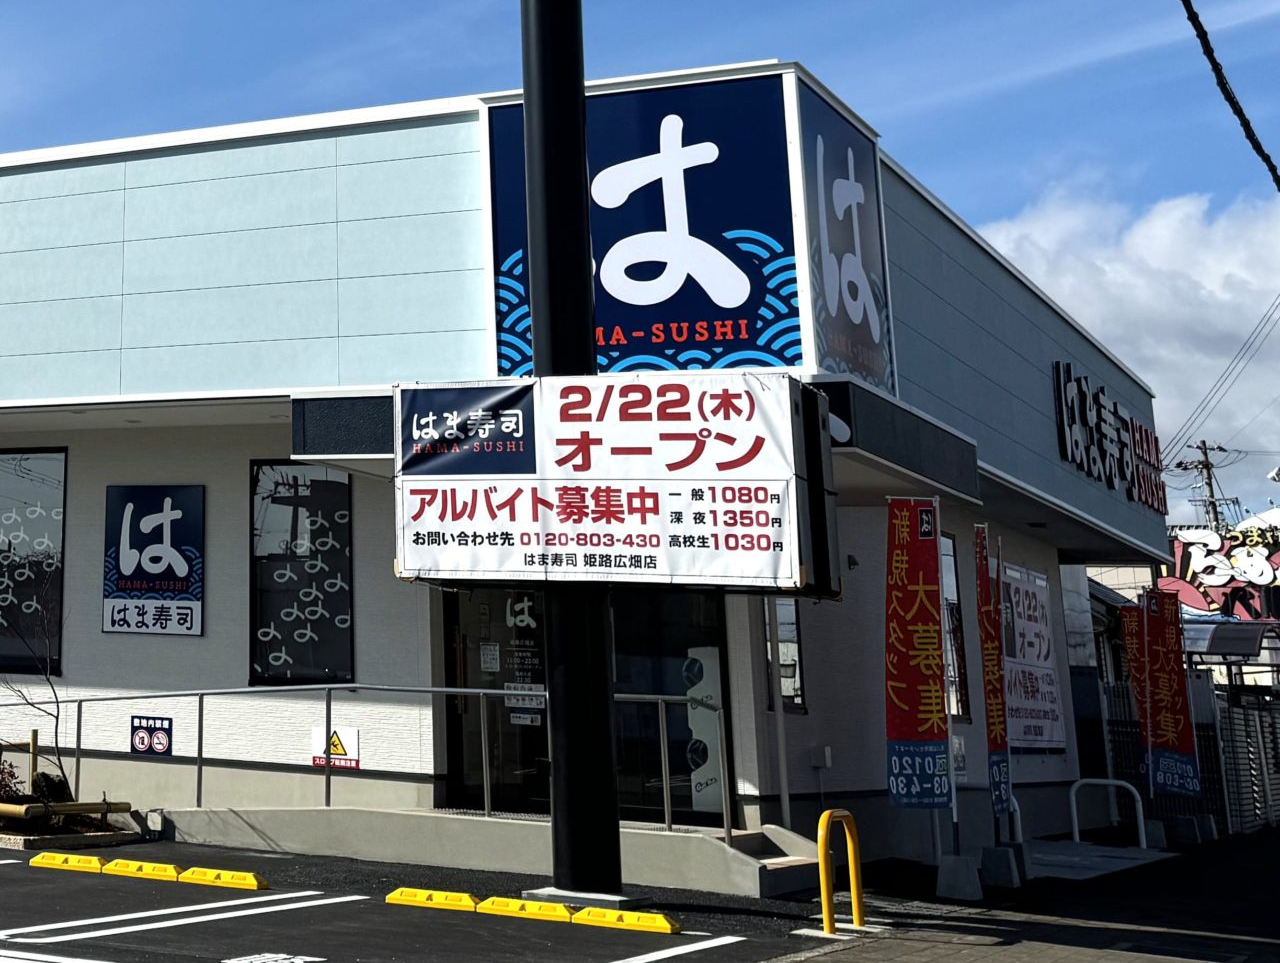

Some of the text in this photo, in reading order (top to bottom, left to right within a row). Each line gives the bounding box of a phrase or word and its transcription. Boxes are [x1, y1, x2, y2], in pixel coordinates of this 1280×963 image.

[816, 134, 880, 343] は
[595, 319, 749, 346] A-SUSHI
[559, 384, 756, 423] 2/22(木)
[413, 409, 524, 440] はま寿司
[1053, 361, 1140, 502] はま寿司
[412, 441, 524, 454] HAMA-SUSHI
[555, 428, 766, 473] オープン
[1131, 417, 1163, 471] HAMA
[409, 485, 660, 525] アルバイト募集中
[1137, 464, 1168, 515] SUSHI
[119, 497, 189, 577] は
[412, 531, 660, 548] お問い合わせ先 0120-803-430
[523, 552, 658, 569] はま寿司 姫路広畑店
[118, 580, 188, 590] HAMA-SUSHI
[111, 603, 194, 630] はま寿司
[505, 596, 537, 629] は
